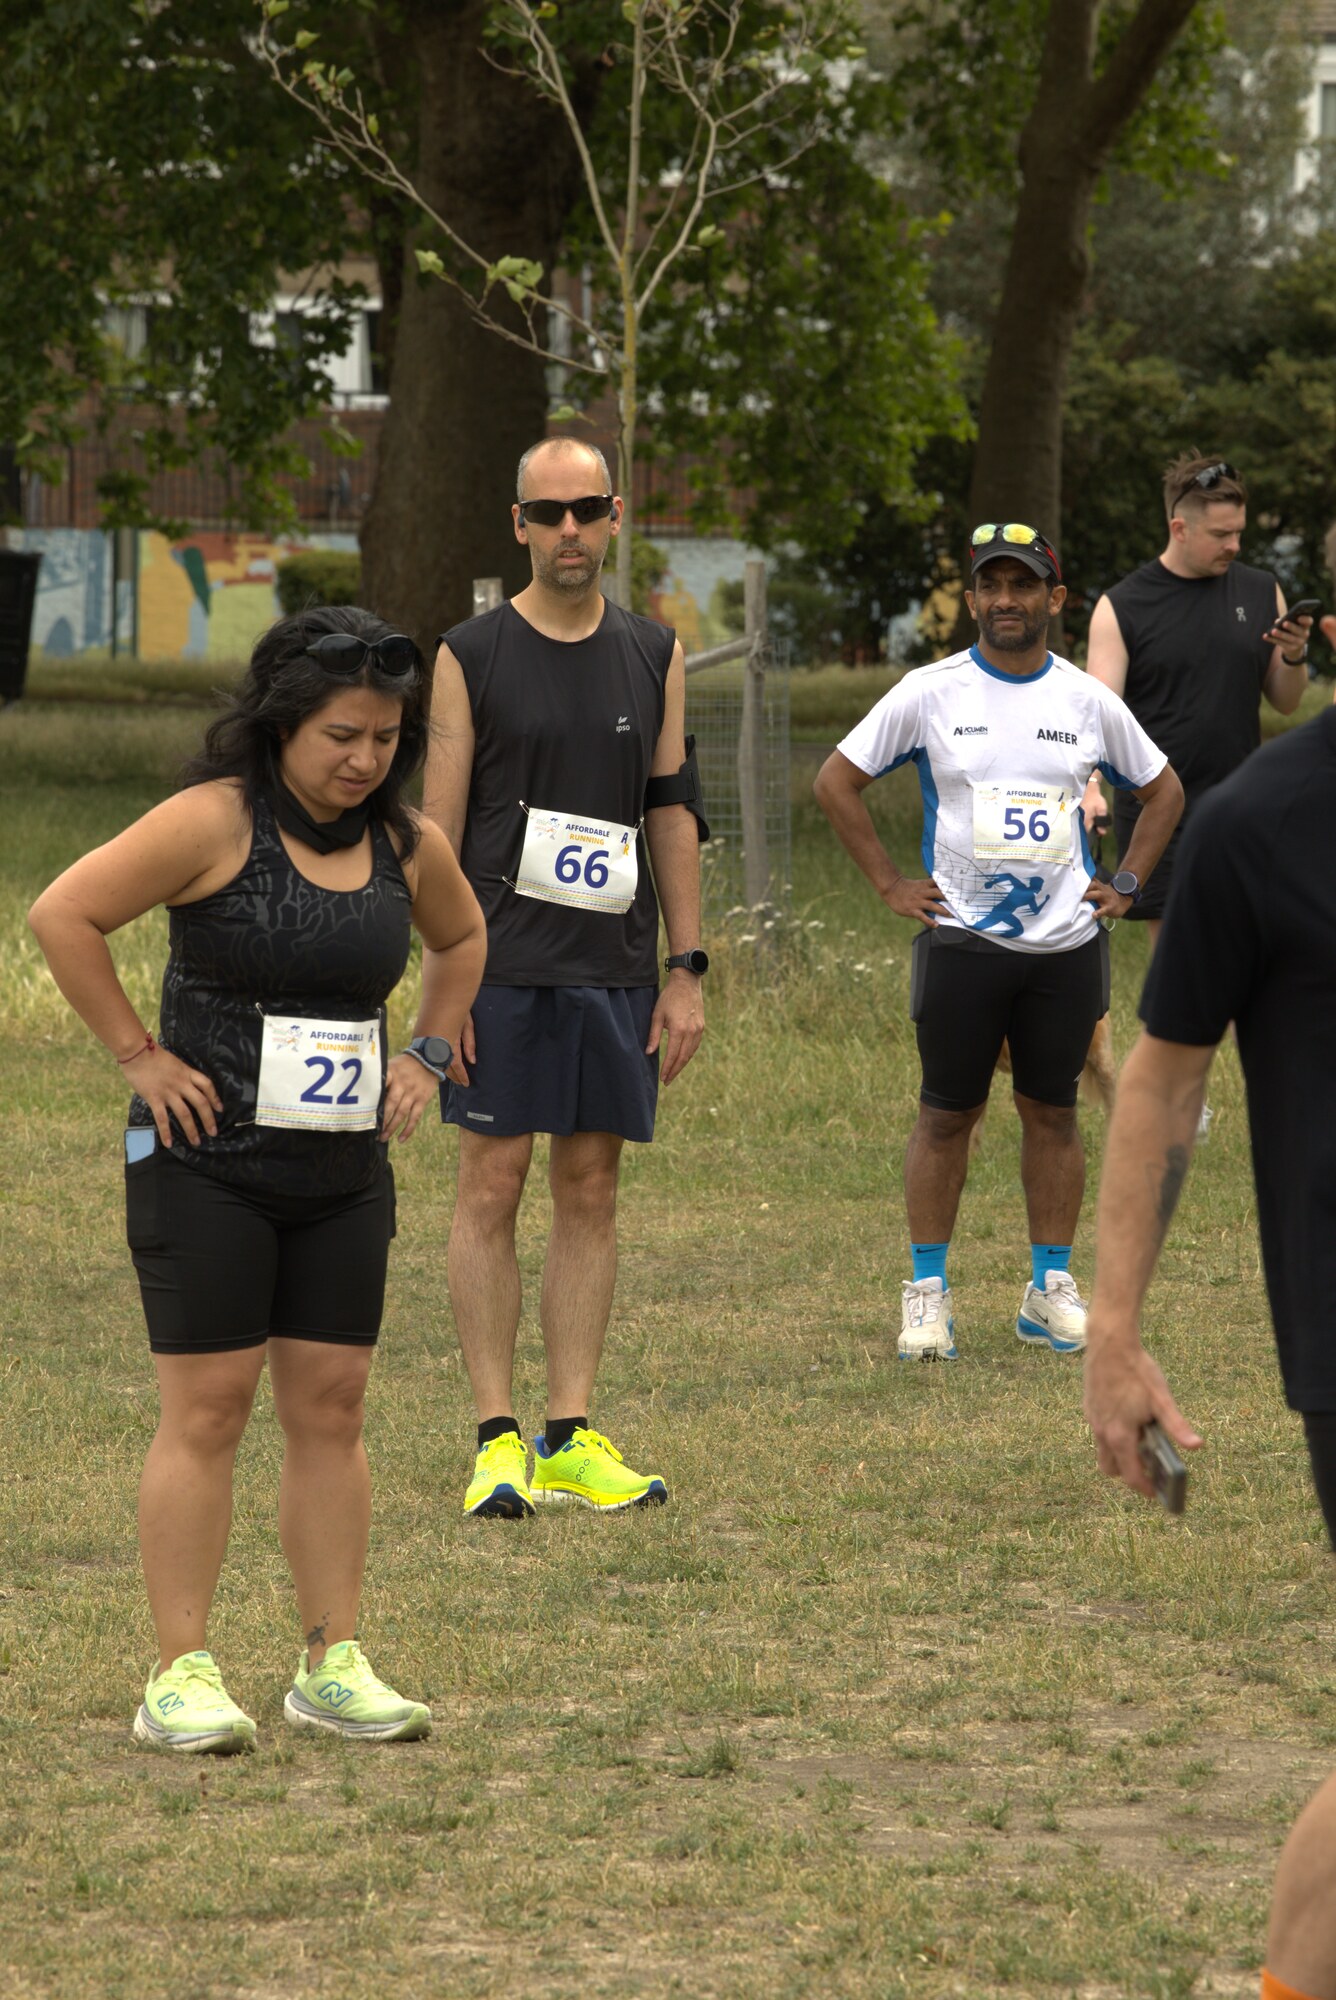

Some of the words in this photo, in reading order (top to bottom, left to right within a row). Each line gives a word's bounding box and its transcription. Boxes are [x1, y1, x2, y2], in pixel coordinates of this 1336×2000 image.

[1036, 728, 1078, 746] AMEER
[1006, 790, 1047, 799] AFFORDABLE
[1011, 798, 1042, 806] RUNNING
[565, 823, 610, 838] AFFORDABLE
[1003, 807, 1050, 842] 56
[569, 833, 605, 846] RUNNING
[620, 832, 629, 844] A
[623, 843, 630, 856] R
[554, 844, 610, 889] 66
[310, 1030, 364, 1041] AFFORDABLE
[316, 1042, 360, 1053] RUNNING
[300, 1055, 363, 1105] 22
